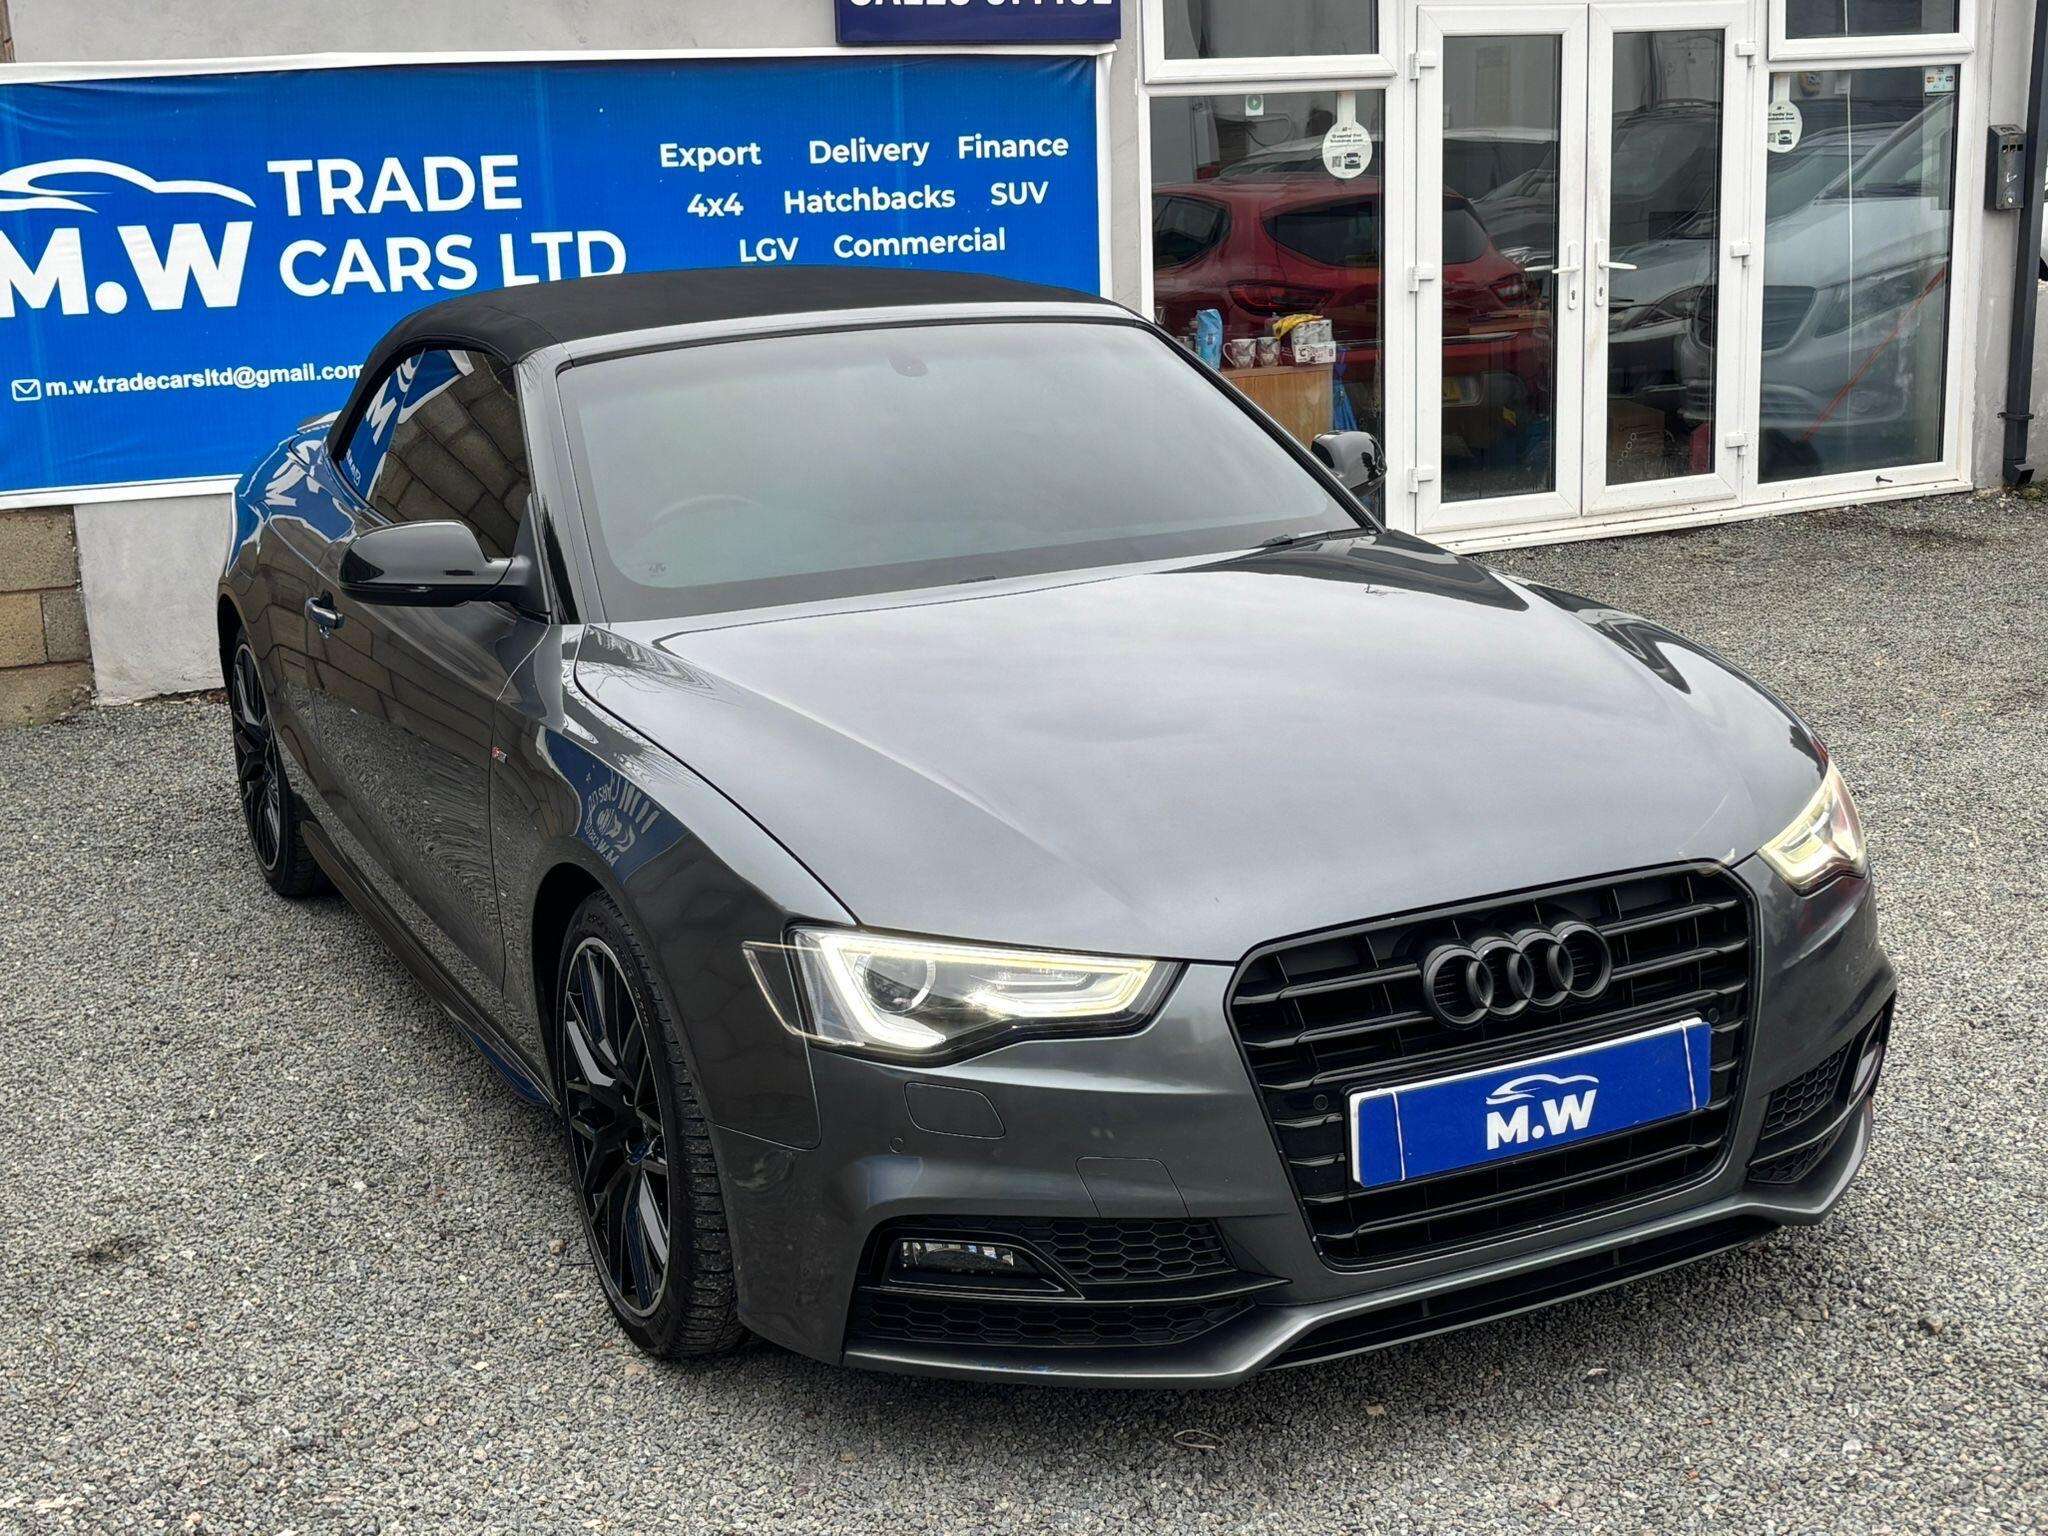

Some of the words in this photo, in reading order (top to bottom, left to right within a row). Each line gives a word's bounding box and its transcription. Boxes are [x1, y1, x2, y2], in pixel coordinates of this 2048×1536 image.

[661, 142, 762, 172] Export
[809, 136, 930, 167] Delivery
[958, 133, 1069, 160] Finance
[267, 155, 522, 216] TRADE
[687, 193, 744, 217] 4x4
[784, 184, 956, 214] Hatchbacks
[990, 181, 1049, 206] SUV
[280, 235, 477, 297] CARS
[500, 230, 626, 286] LTD
[740, 238, 799, 263] LGV
[833, 227, 1006, 259] Commercial
[0, 222, 252, 318] M.W
[46, 363, 364, 397] m.w.tradecarsltd@gmail.com
[1486, 1090, 1597, 1150] M.W
